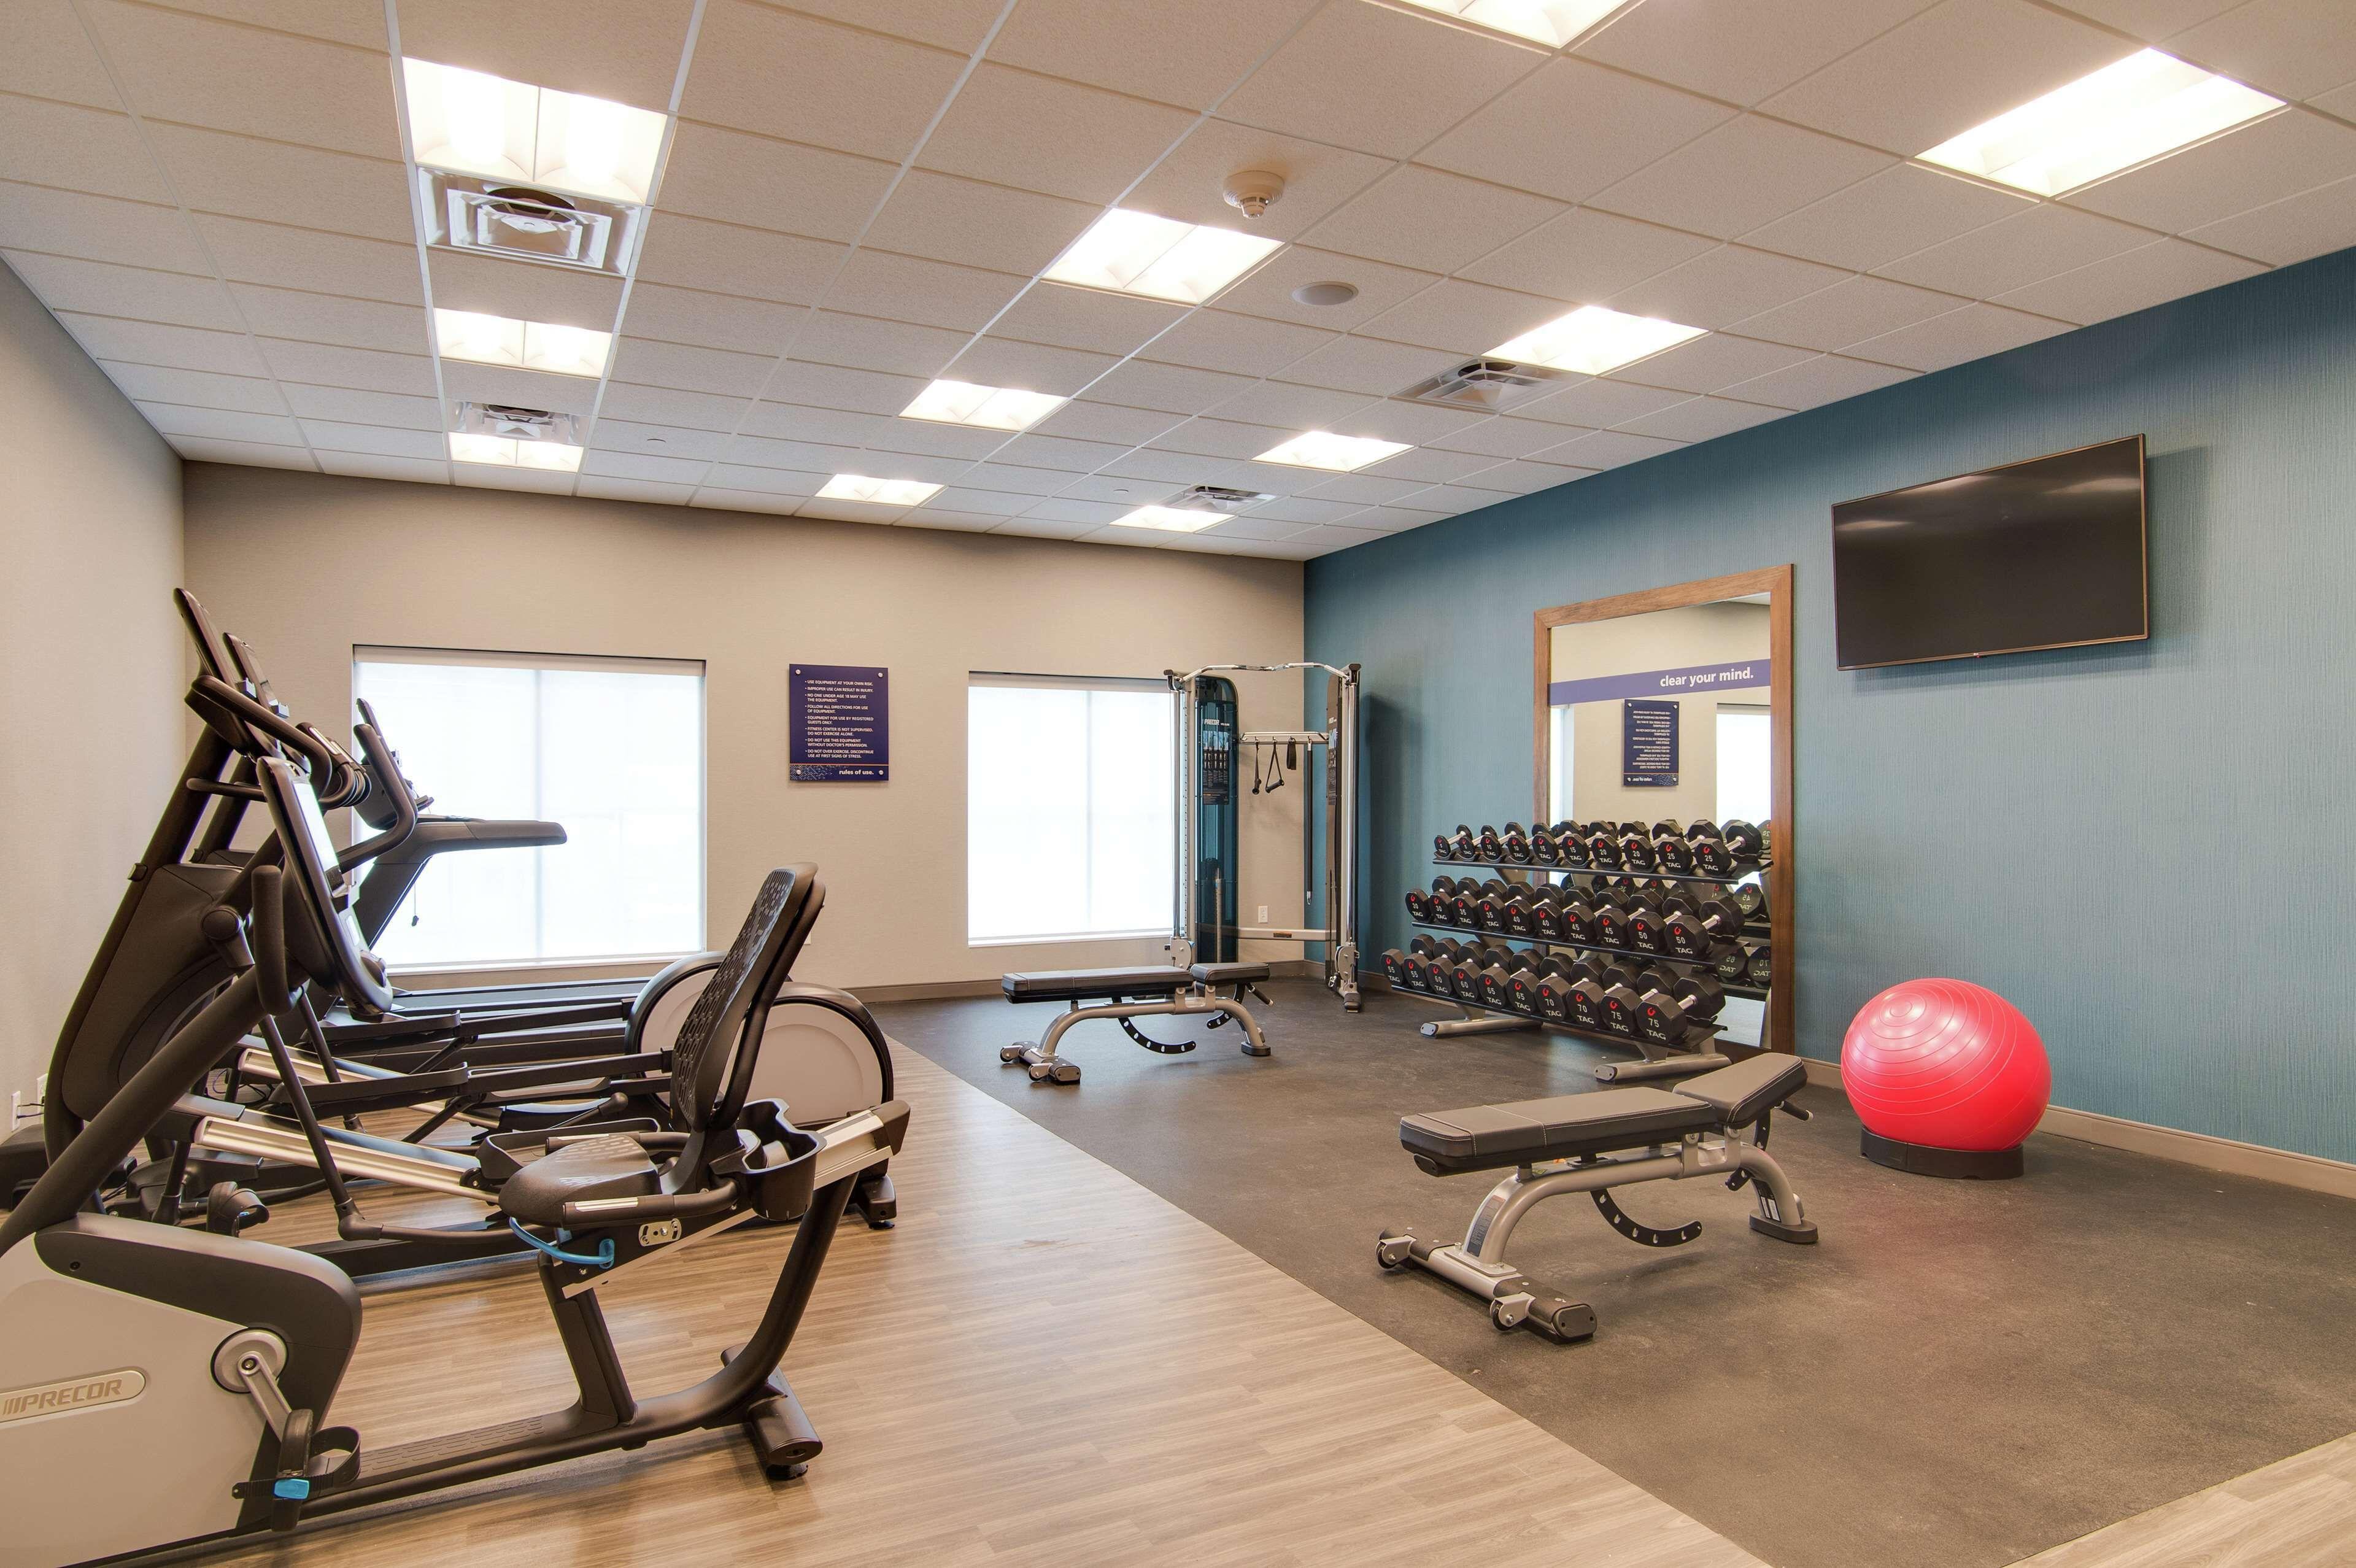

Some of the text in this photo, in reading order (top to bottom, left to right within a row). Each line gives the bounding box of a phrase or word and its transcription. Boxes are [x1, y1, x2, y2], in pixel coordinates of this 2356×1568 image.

[1660, 667, 1754, 687] clear your mind.
[1515, 1002, 1531, 1011] TAG
[1578, 1004, 1587, 1013] 70
[1611, 1011, 1621, 1020] 75
[1610, 1022, 1628, 1032] TAG
[1648, 1018, 1659, 1027] 75
[1647, 1029, 1666, 1040] TAG
[20, 1379, 122, 1412] PRECOR
